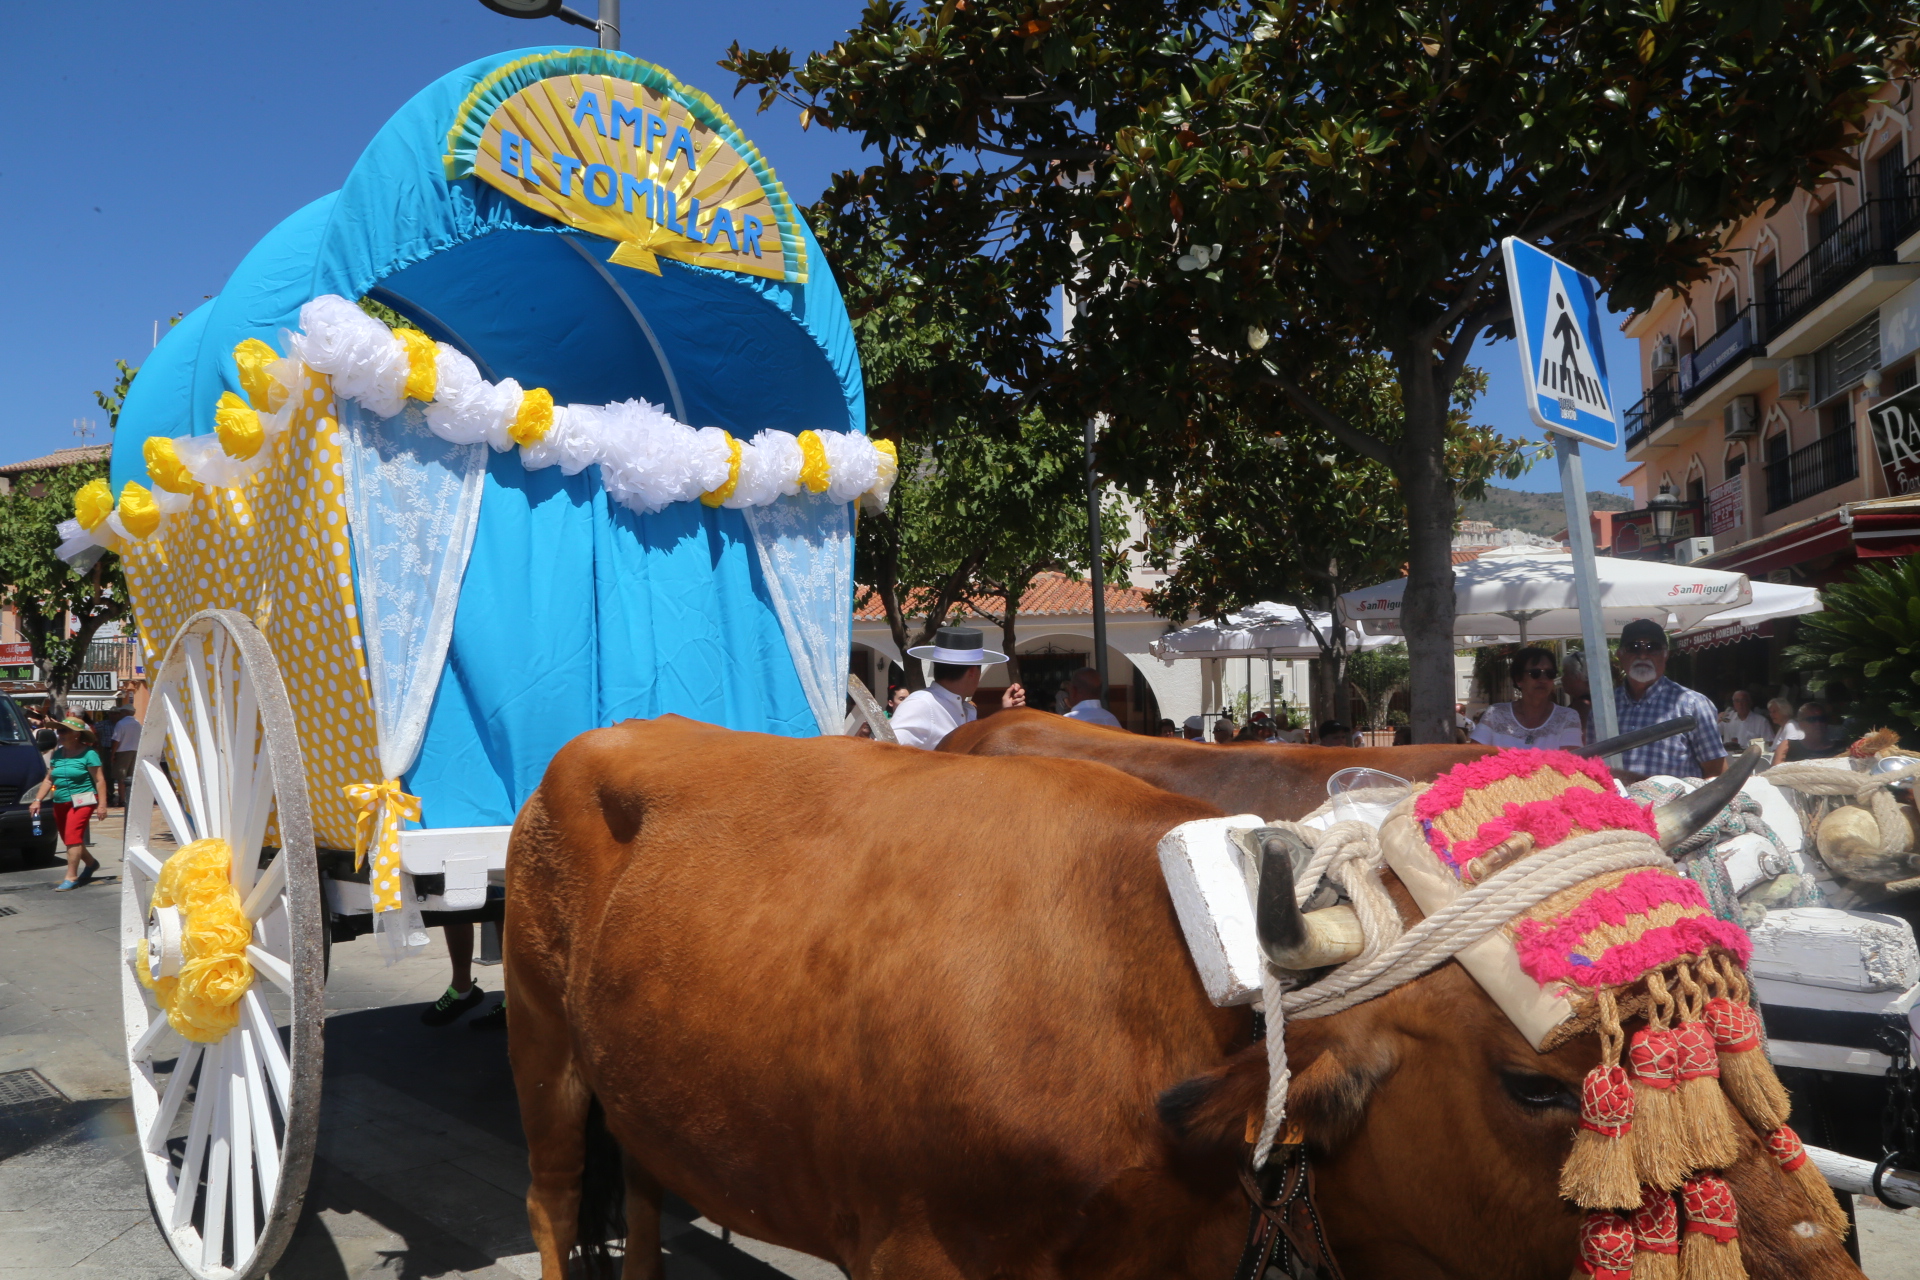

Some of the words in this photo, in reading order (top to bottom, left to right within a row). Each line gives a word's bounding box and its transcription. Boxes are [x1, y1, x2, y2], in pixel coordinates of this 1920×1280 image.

[572, 91, 696, 171] AMPA
[500, 128, 540, 186] EL
[552, 151, 763, 258] TOMILLAR
[1356, 599, 1402, 612] SanMigu
[1693, 632, 1712, 645] SNACKS
[1715, 624, 1743, 639] HOMEMADE
[1251, 1120, 1300, 1142] 109
